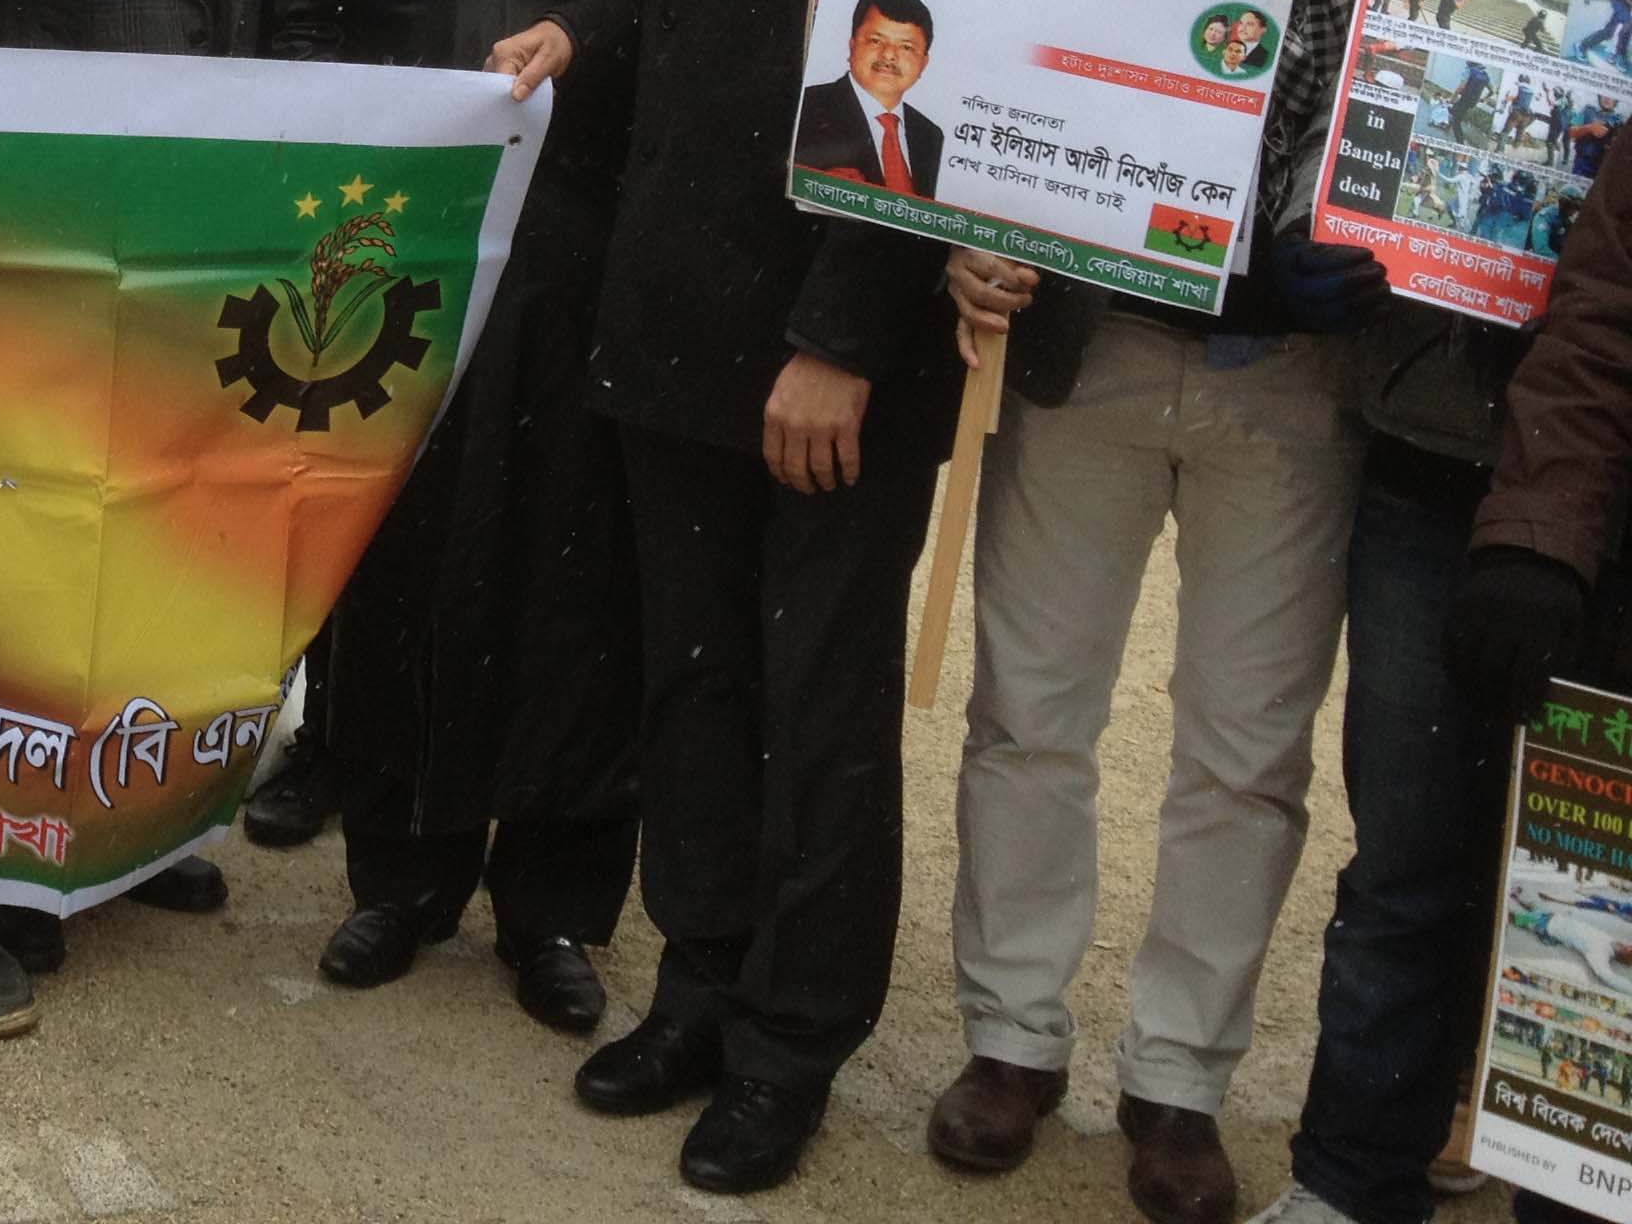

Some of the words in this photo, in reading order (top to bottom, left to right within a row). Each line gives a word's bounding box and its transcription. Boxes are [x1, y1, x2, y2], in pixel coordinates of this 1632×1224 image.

[961, 95, 1003, 116] নন্দিত
[1008, 108, 1066, 132] জননেতা
[1196, 83, 1258, 109] বাংলাদেশ
[1367, 110, 1385, 130] in
[954, 123, 986, 148] এম
[990, 123, 1059, 166] ইলিয়াস
[1065, 146, 1112, 178] আলী
[1117, 153, 1186, 197] নিখোঁজ
[1191, 179, 1236, 209] কেন
[1338, 138, 1402, 170] Bangla
[948, 155, 983, 174] শেখ
[987, 164, 1040, 189] হাসিনা
[1045, 179, 1090, 201] জবাব
[1096, 191, 1126, 213] চাই
[1339, 176, 1382, 202] desh
[804, 177, 870, 210] বাংলাদেশ
[873, 195, 969, 236] জাতীয়তাবাদী
[973, 223, 999, 244] দল
[1086, 256, 1168, 292] বেলজিয়াম
[1171, 279, 1211, 303] শাখা
[1324, 213, 1404, 252] বাংলাদেশ
[1408, 235, 1516, 281] জাতীয়তাবাদী
[1519, 268, 1547, 291] দল
[1409, 272, 1491, 307] বেলজিয়াম
[1495, 293, 1535, 321] শাখা
[1528, 792, 1585, 824] OVER
[1593, 811, 1622, 835] 100
[1527, 824, 1551, 844] NO
[1555, 830, 1606, 860] MORE
[1495, 1080, 1528, 1115] বিশ্ব
[1532, 1094, 1587, 1133] বিবেক
[1480, 1136, 1541, 1165] PUBLISHED
[1542, 1160, 1558, 1172] BY
[1579, 1163, 1632, 1197] BNP
